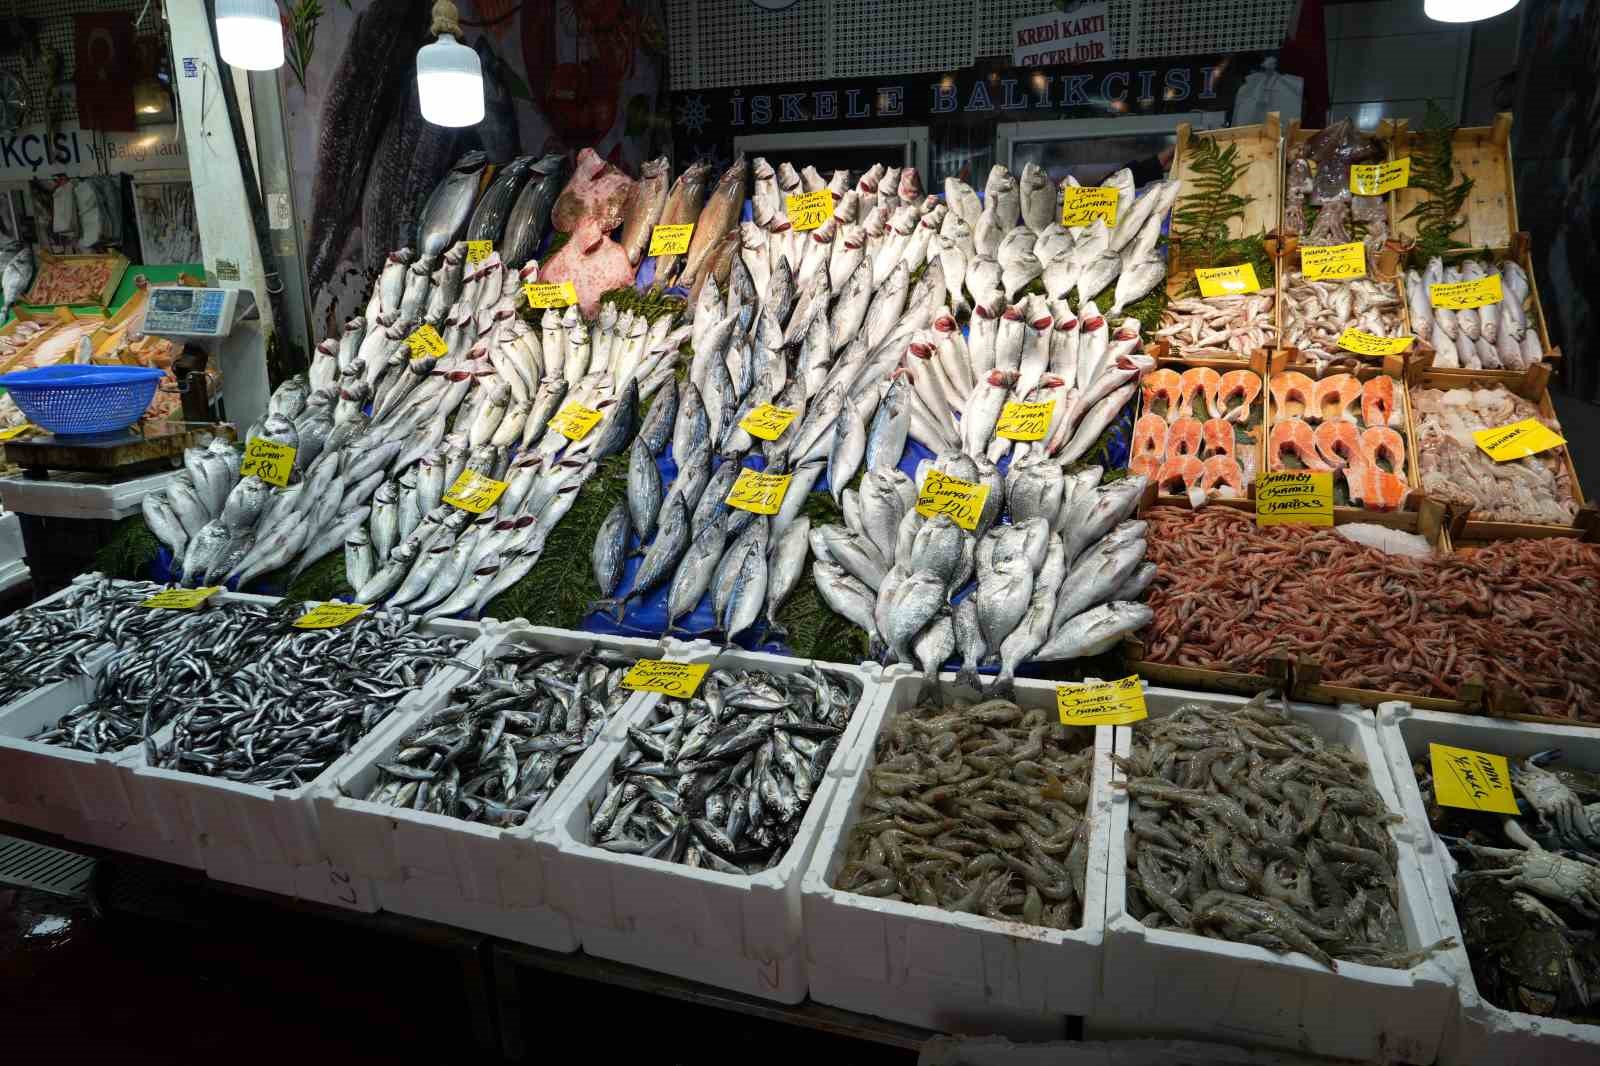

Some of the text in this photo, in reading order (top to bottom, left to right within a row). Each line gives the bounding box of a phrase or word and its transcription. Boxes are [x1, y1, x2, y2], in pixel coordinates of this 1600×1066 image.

[1017, 15, 1104, 47] KREDİ KARTI
[730, 86, 904, 125] İSKELE
